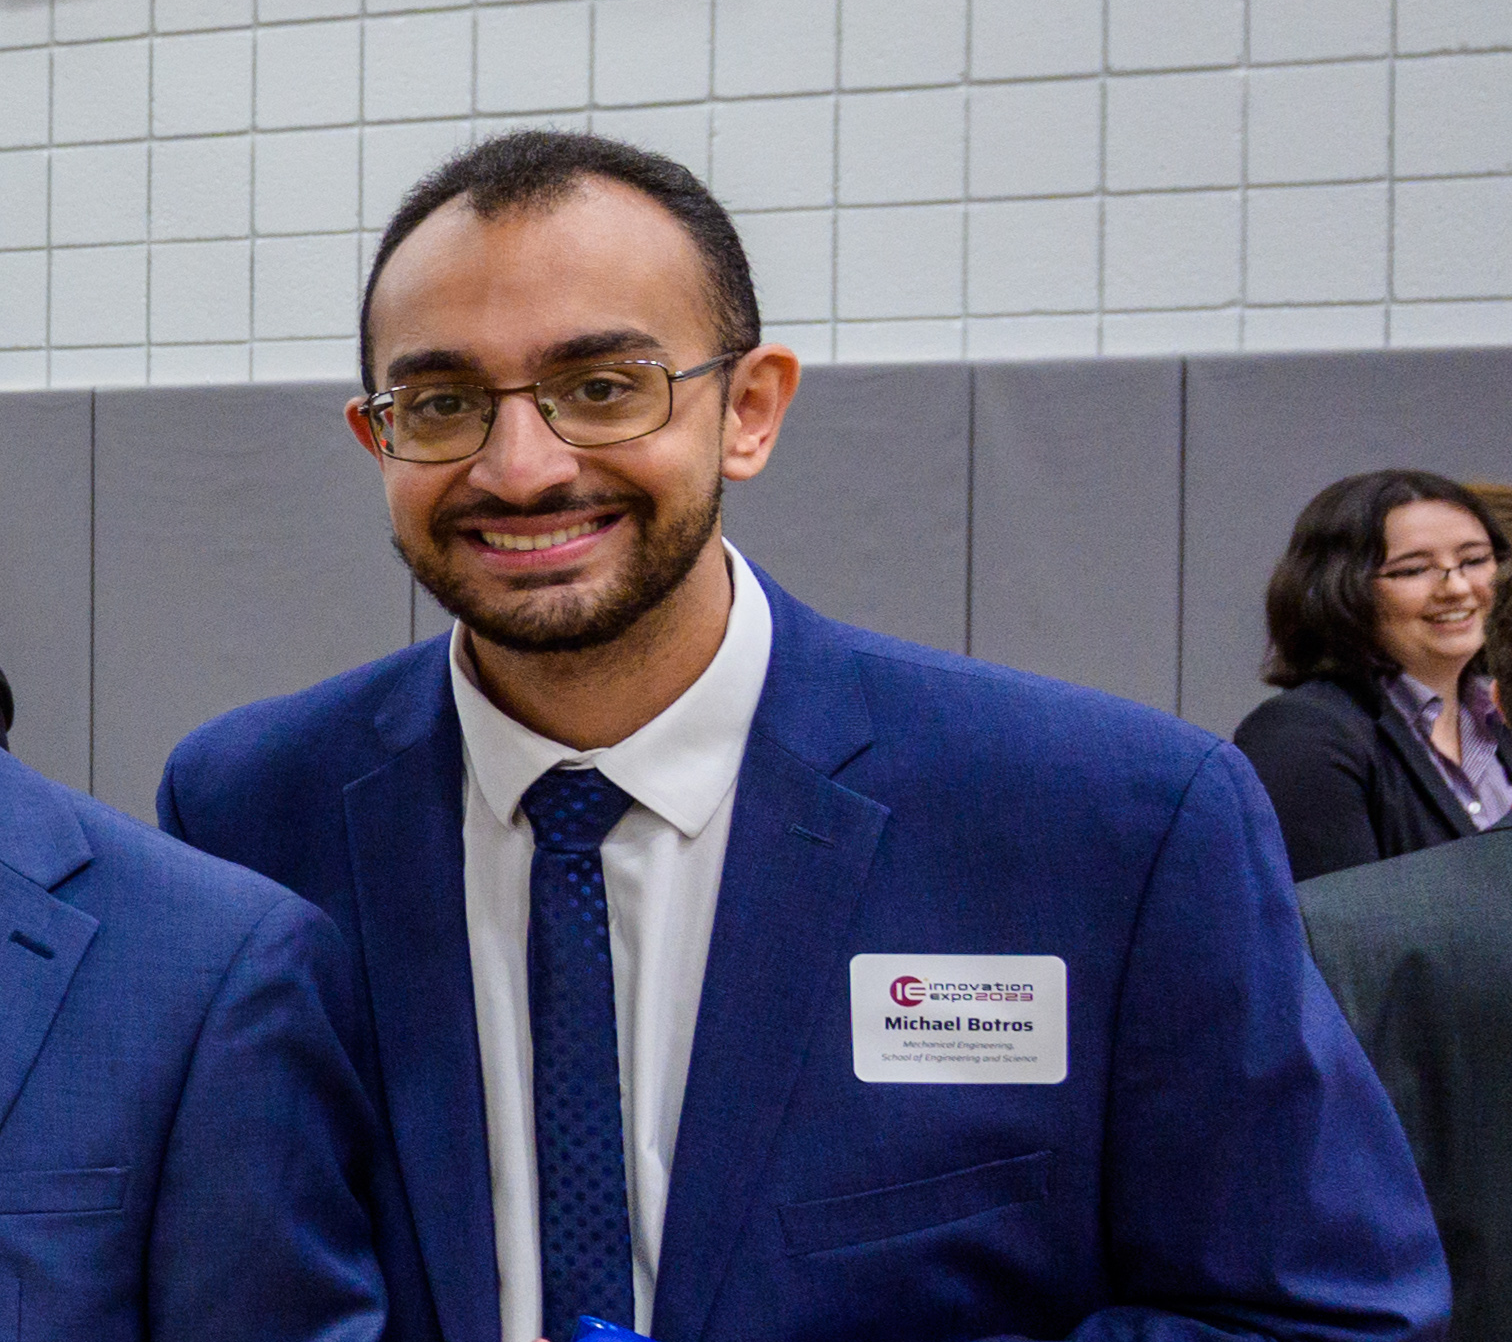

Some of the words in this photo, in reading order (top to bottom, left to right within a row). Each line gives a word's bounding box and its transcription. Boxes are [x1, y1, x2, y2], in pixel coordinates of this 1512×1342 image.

[928, 981, 1034, 992] innovation
[884, 1016, 961, 1032] Michael
[967, 1017, 1034, 1032] Botros
